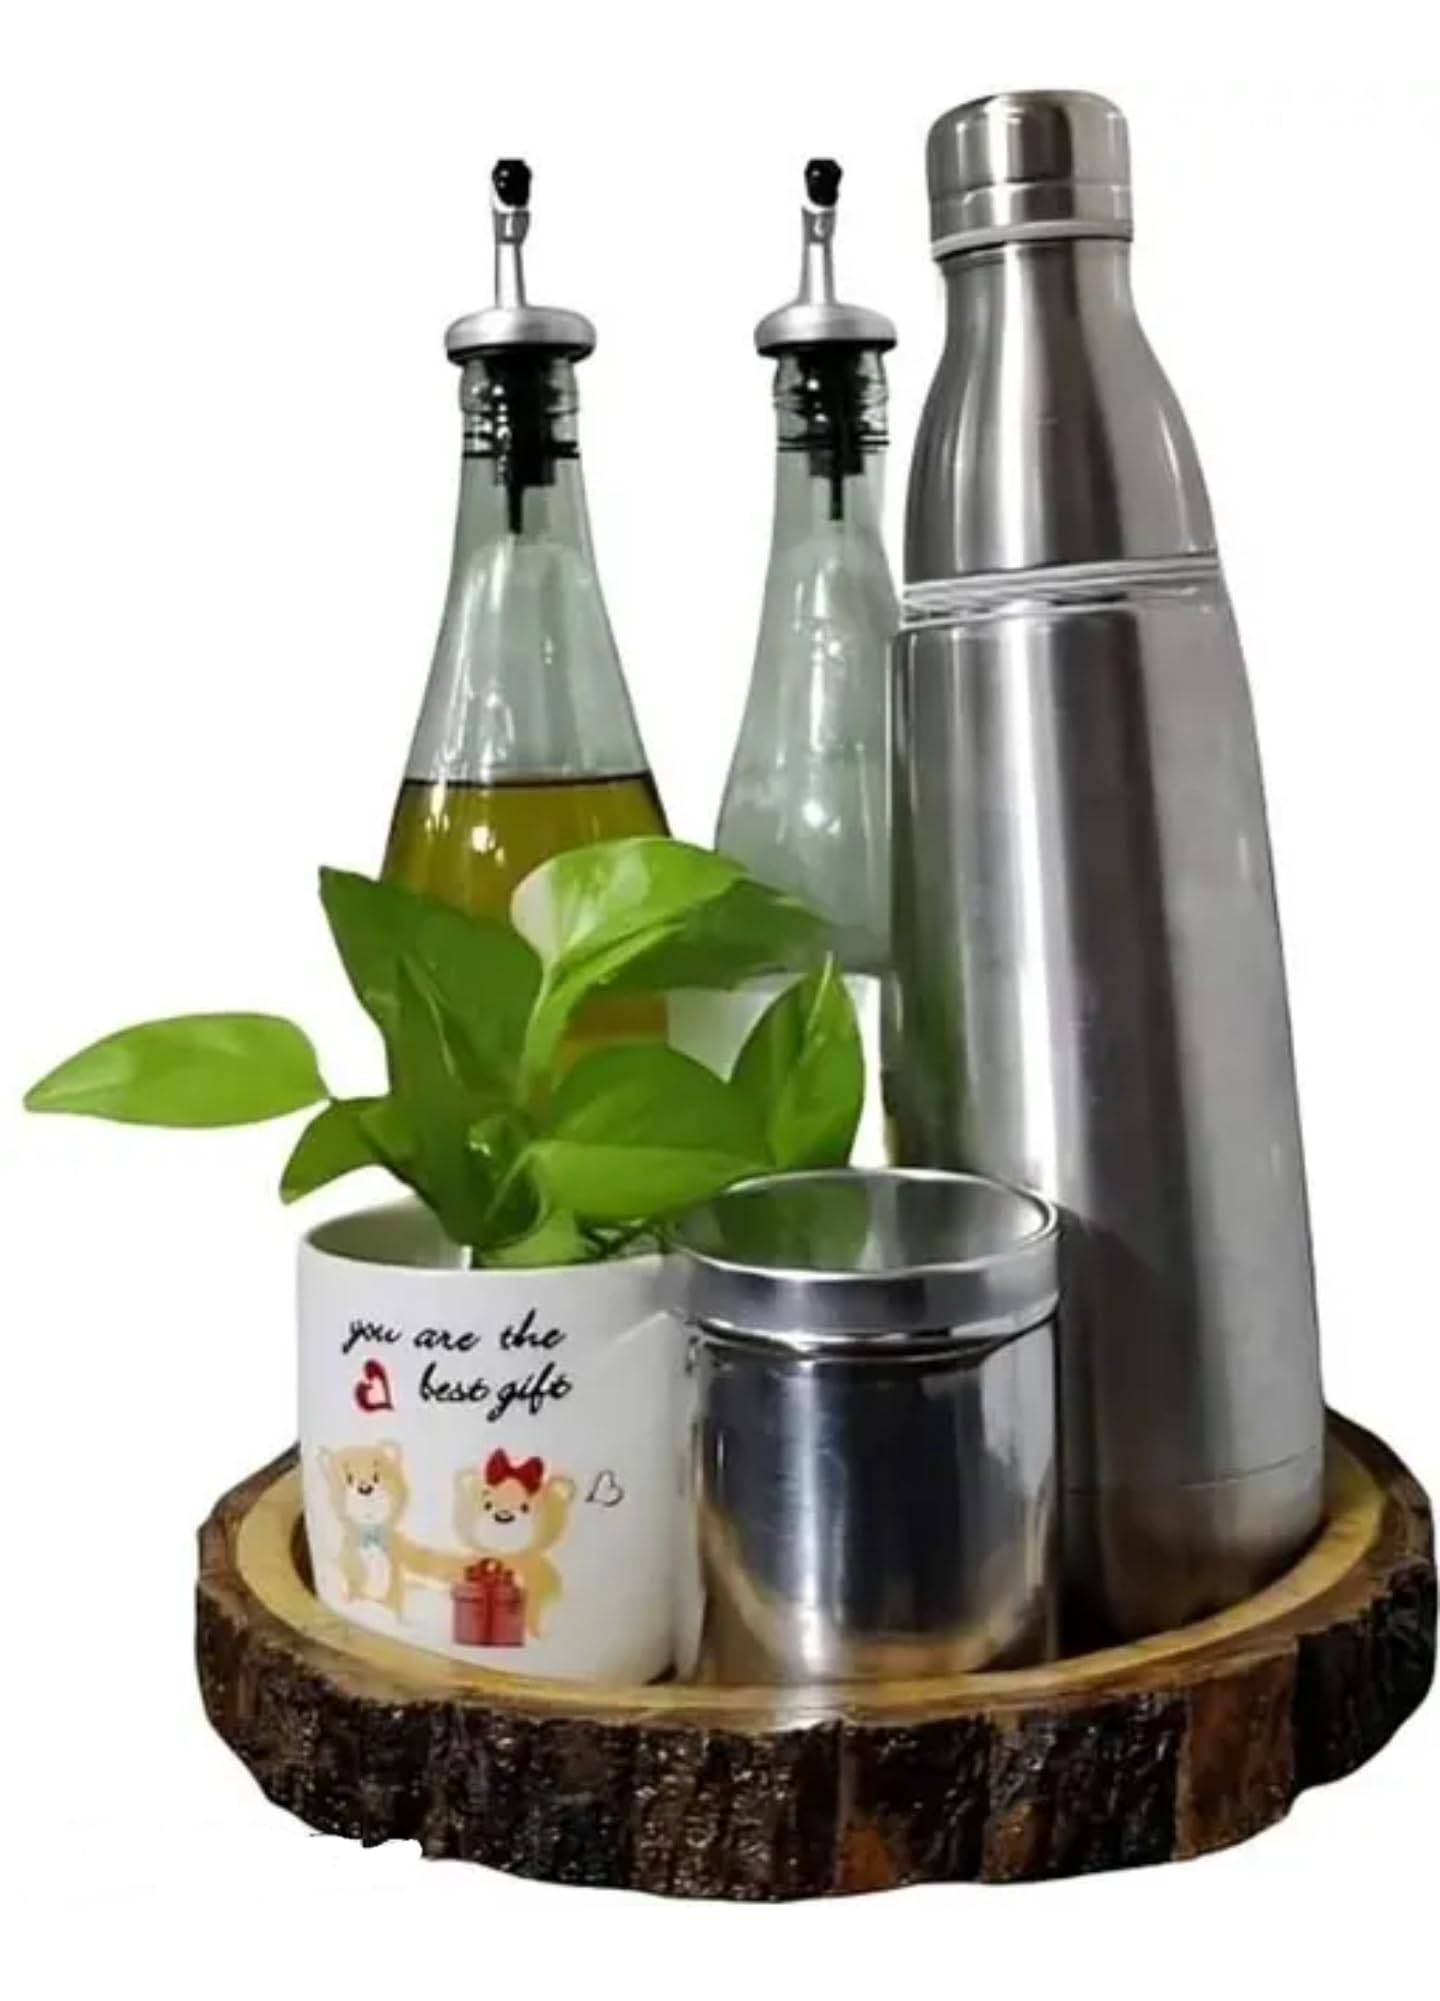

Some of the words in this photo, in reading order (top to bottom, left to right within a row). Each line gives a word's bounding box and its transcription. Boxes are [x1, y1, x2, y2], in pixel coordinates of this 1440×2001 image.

[342, 1319, 402, 1354] you
[413, 1327, 481, 1351] are
[499, 1308, 567, 1351] the
[419, 1361, 491, 1402] best
[485, 1361, 573, 1423] gift
